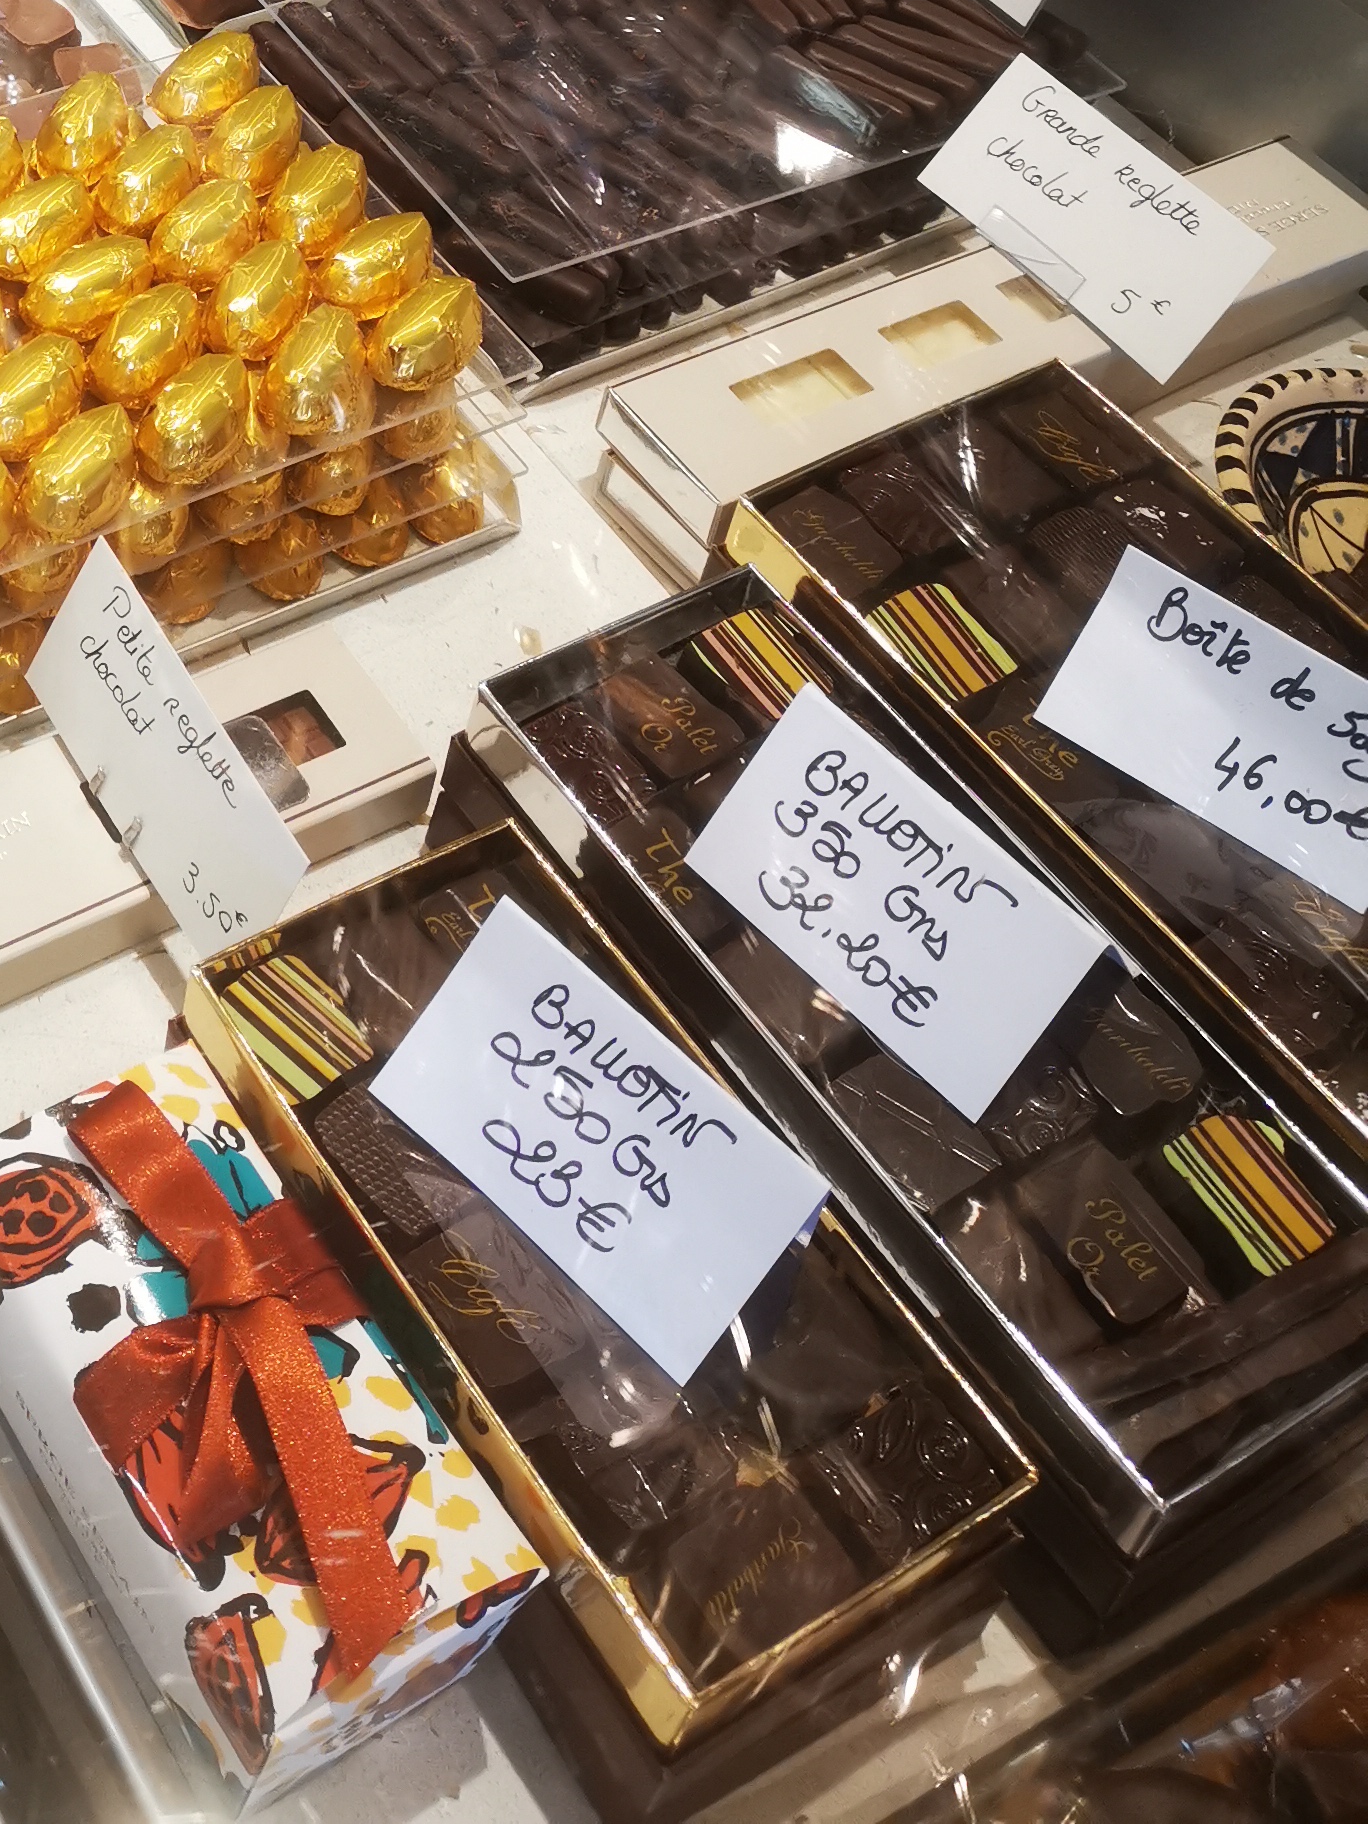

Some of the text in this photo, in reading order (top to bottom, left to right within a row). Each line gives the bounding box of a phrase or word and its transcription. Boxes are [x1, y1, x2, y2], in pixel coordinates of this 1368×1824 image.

[1110, 287, 1142, 314] 5
[101, 585, 155, 687] Petite
[1269, 666, 1316, 712] de
[639, 722, 674, 754] Or
[660, 696, 719, 756] Palet
[1065, 1236, 1102, 1279] Or
[1084, 1196, 1158, 1283] Palet
